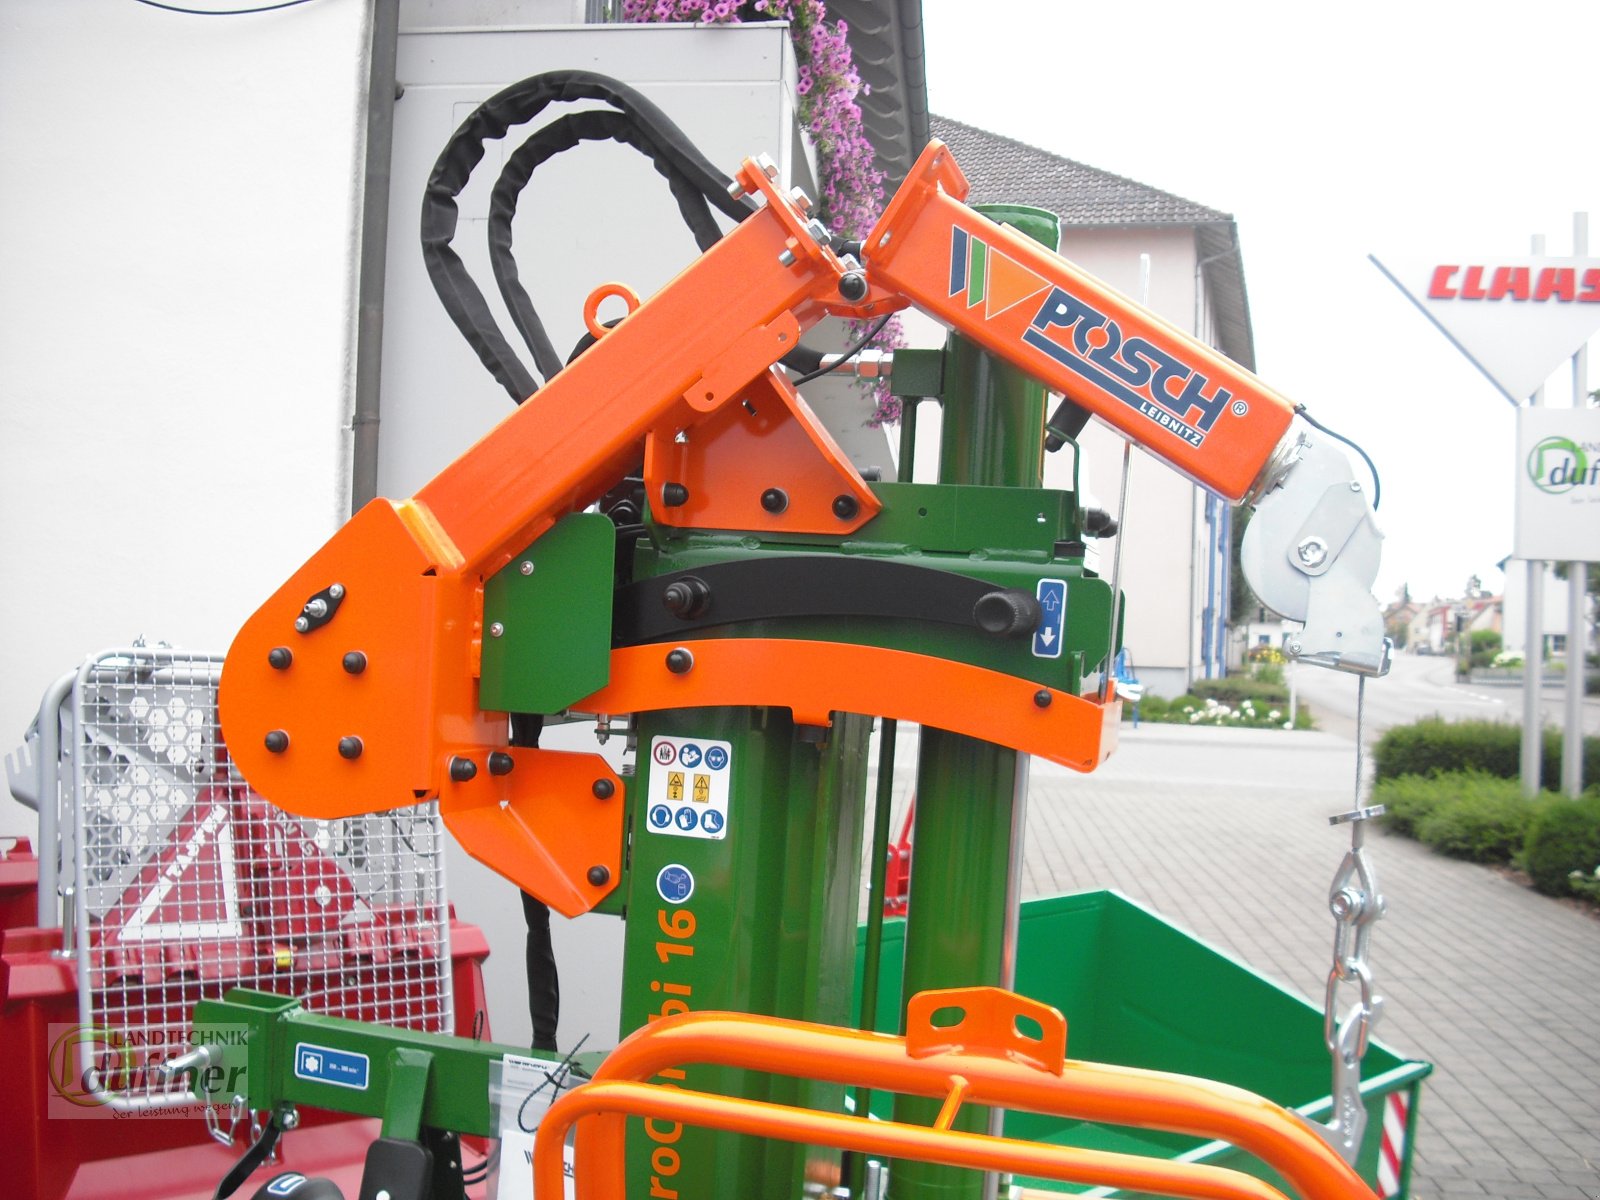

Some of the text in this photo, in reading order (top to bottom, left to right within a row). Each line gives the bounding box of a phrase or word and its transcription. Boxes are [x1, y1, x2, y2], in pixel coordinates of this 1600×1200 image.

[1427, 265, 1600, 303] CLAAS
[1032, 286, 1232, 433] POSCH
[1139, 400, 1203, 446] LEIBNITZ
[656, 908, 697, 963] 16
